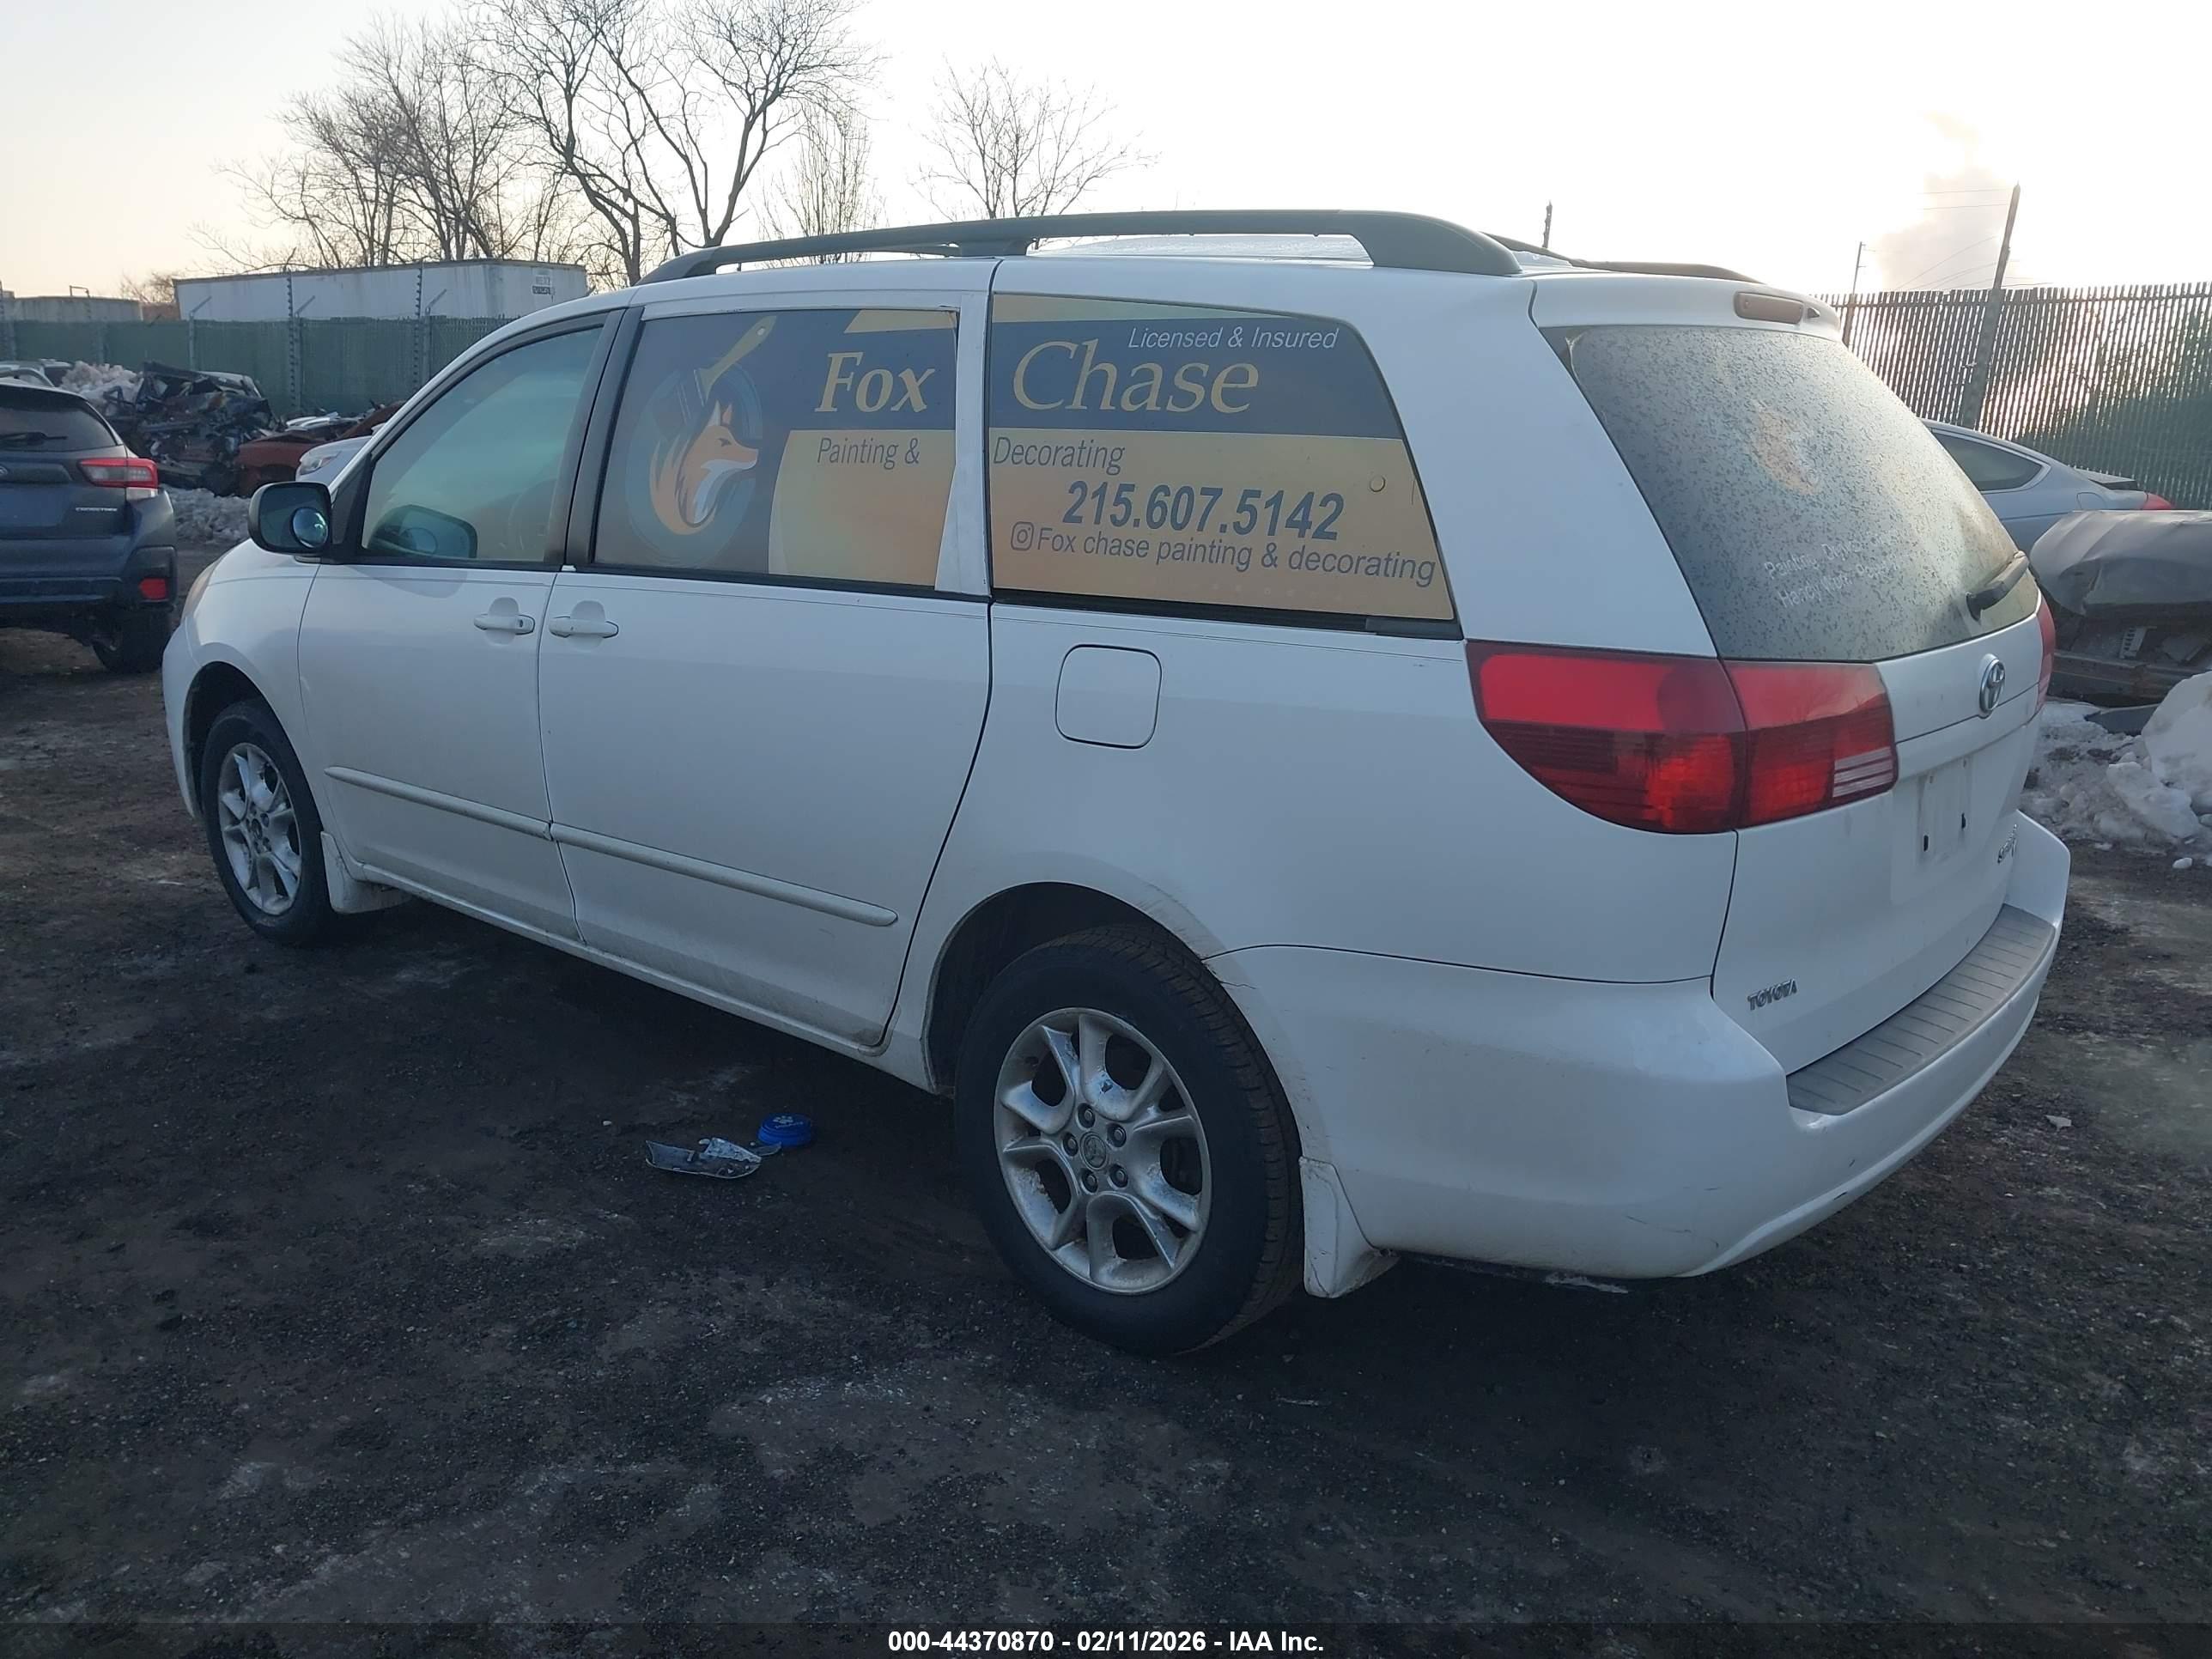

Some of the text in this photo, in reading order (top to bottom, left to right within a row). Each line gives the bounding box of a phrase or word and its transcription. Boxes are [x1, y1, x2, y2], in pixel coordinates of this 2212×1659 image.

[1127, 326, 1340, 349] Licensed & Insured
[814, 337, 1260, 414] Fox Chase
[817, 436, 1126, 476] Painting & Decorating
[1062, 480, 1345, 541] 215.607.5142
[1037, 526, 1437, 587] Fox chase painting & decorating
[1747, 978, 1797, 1011] TOYOTA
